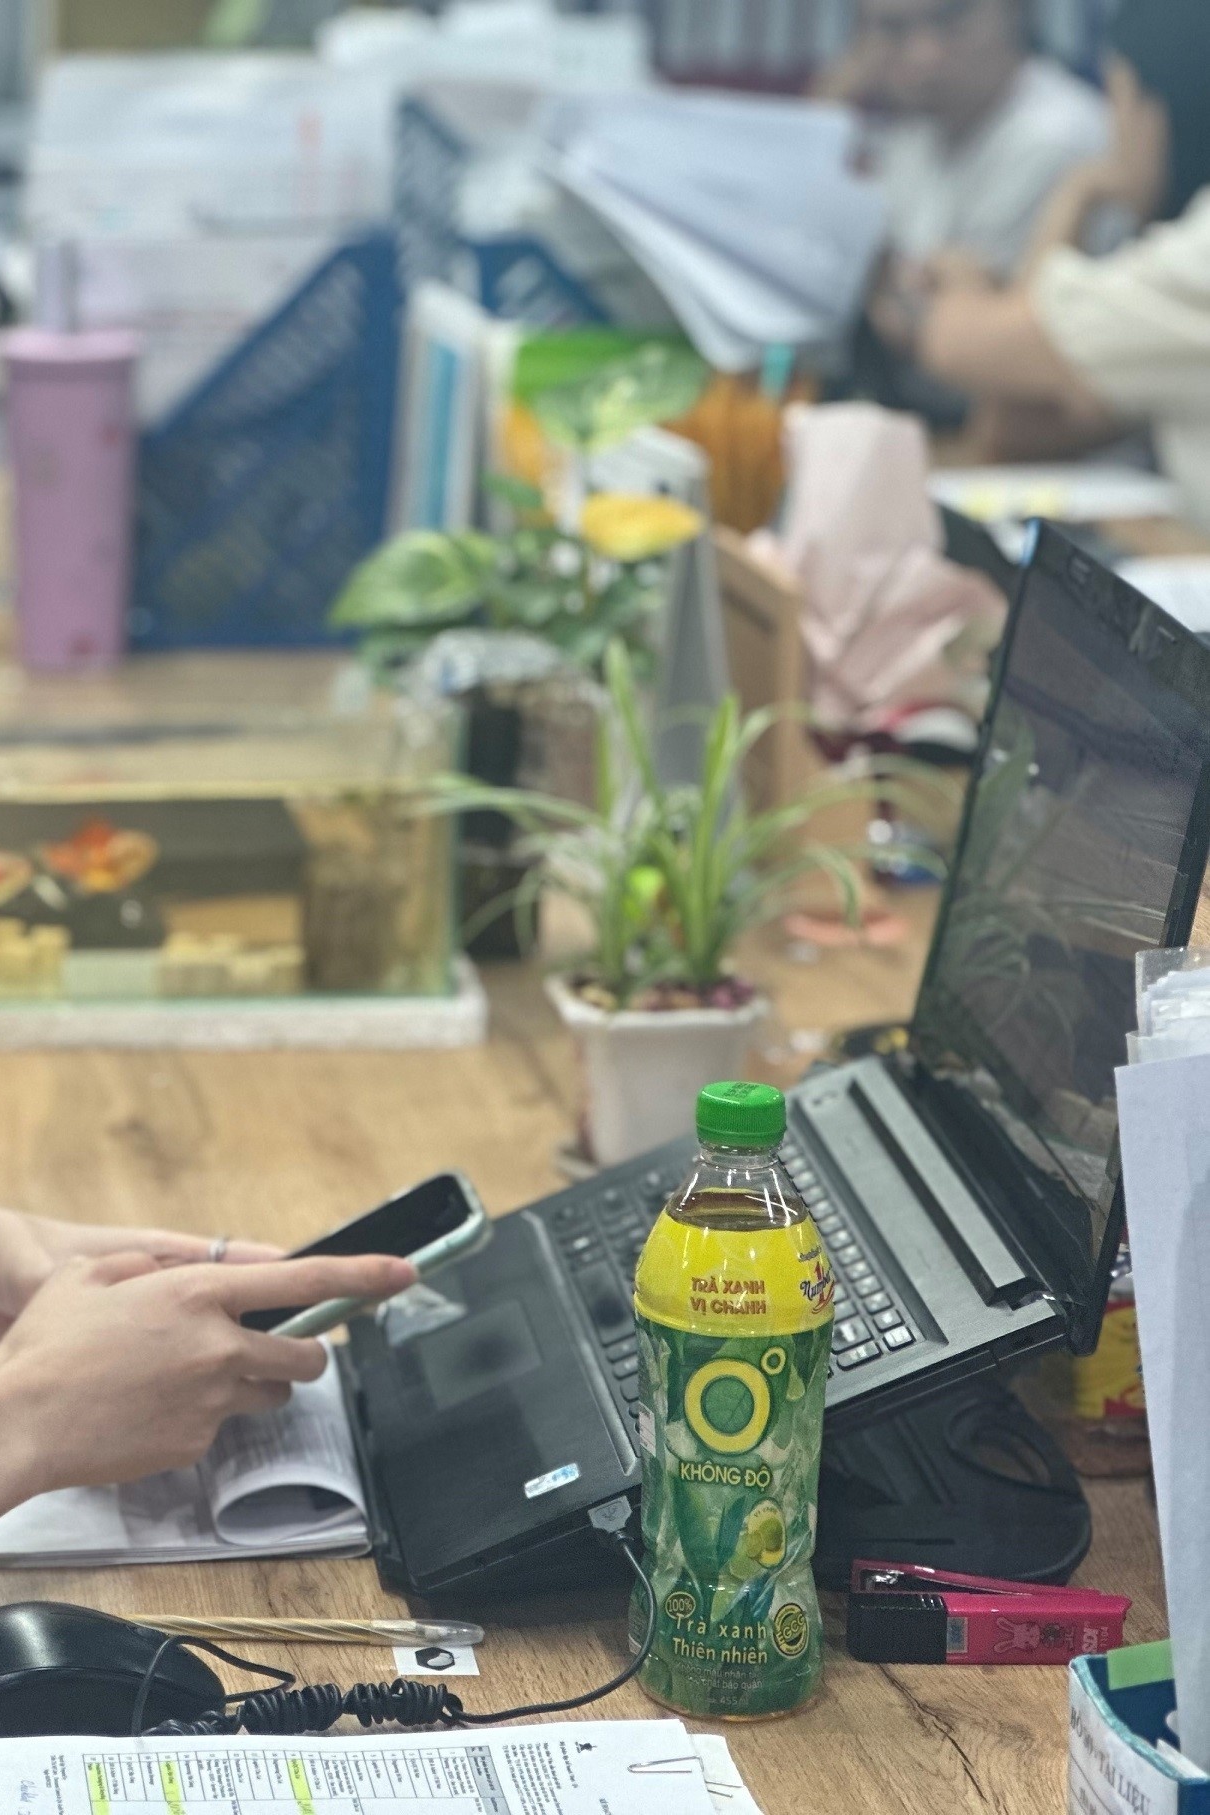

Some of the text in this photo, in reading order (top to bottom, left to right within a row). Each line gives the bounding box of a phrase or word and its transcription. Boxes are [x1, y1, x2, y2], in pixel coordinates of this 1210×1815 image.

[692, 1276, 766, 1295] TRÀ XANH
[691, 1296, 707, 1316] VỊ
[680, 1460, 771, 1492] KHÔNG ĐỘ
[668, 1598, 693, 1613] 100%
[676, 1613, 768, 1640] Trà xanh
[672, 1637, 768, 1665] Thiên nhiên
